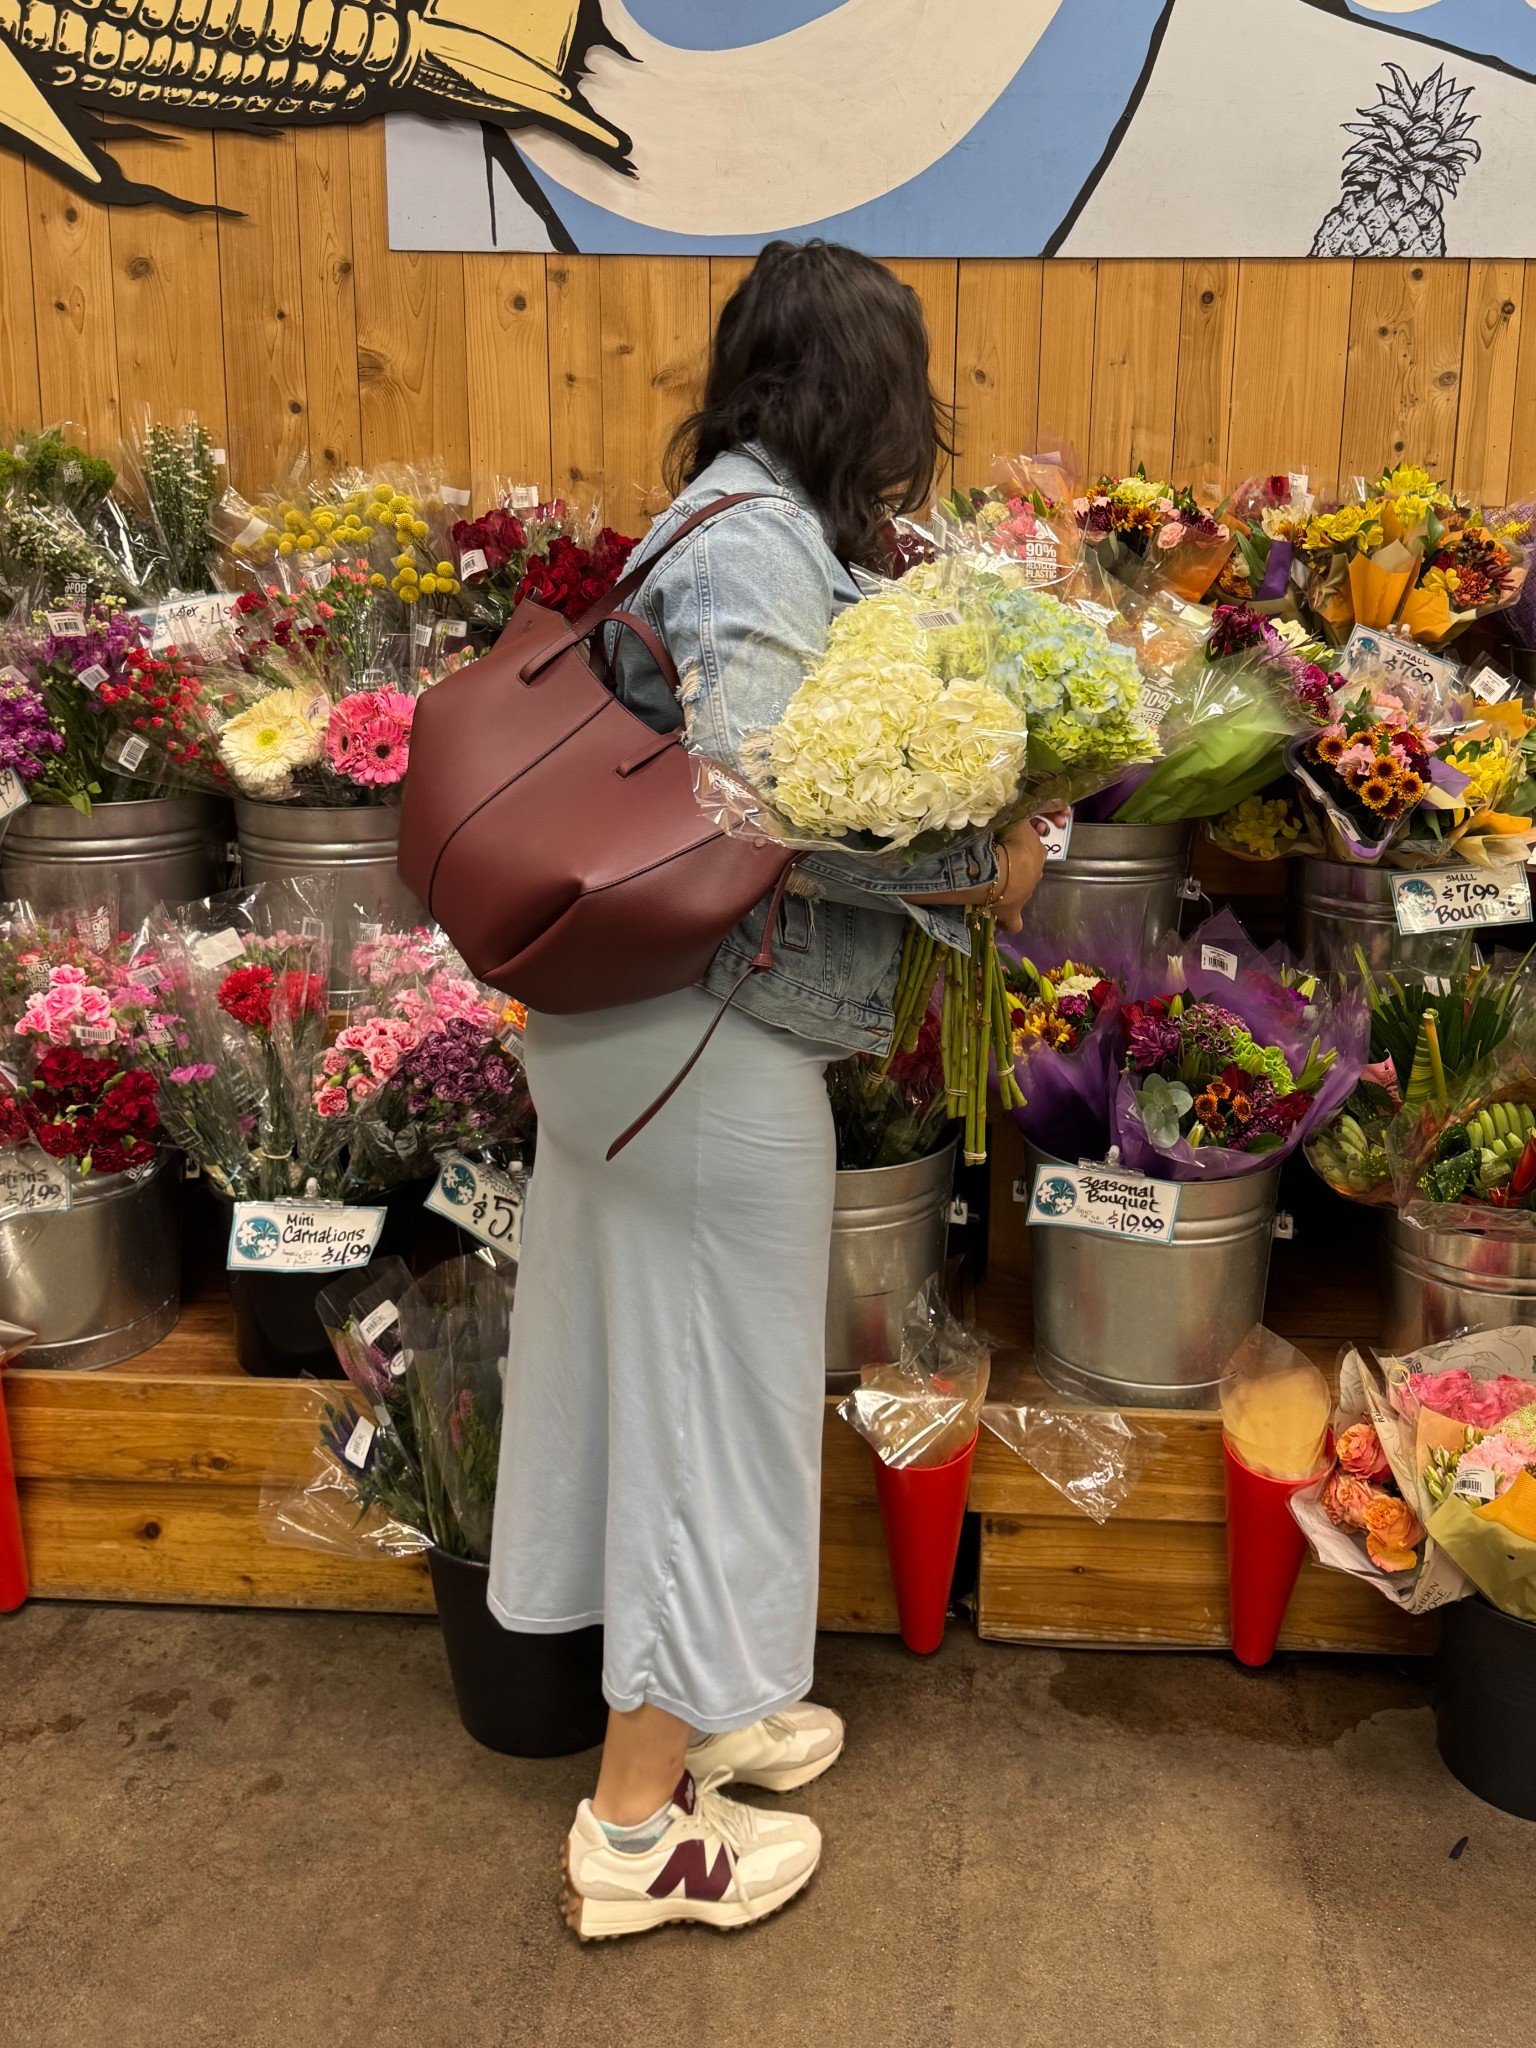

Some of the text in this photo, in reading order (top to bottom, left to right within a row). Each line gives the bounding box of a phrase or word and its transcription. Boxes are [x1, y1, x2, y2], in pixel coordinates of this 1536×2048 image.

[1026, 542, 1057, 558] 90%
[1026, 569, 1057, 579] PLASTIC
[1396, 649, 1430, 667] SMALL
[1445, 873, 1477, 883] SMALL
[1442, 883, 1500, 903] $7.99
[1078, 1176, 1154, 1198] Seasonal
[1085, 1189, 1161, 1214] Bouquet
[286, 1211, 314, 1226] Mini
[1106, 1210, 1165, 1234] $19.99
[282, 1226, 366, 1244] Carnations
[321, 1243, 371, 1266] $4.99
